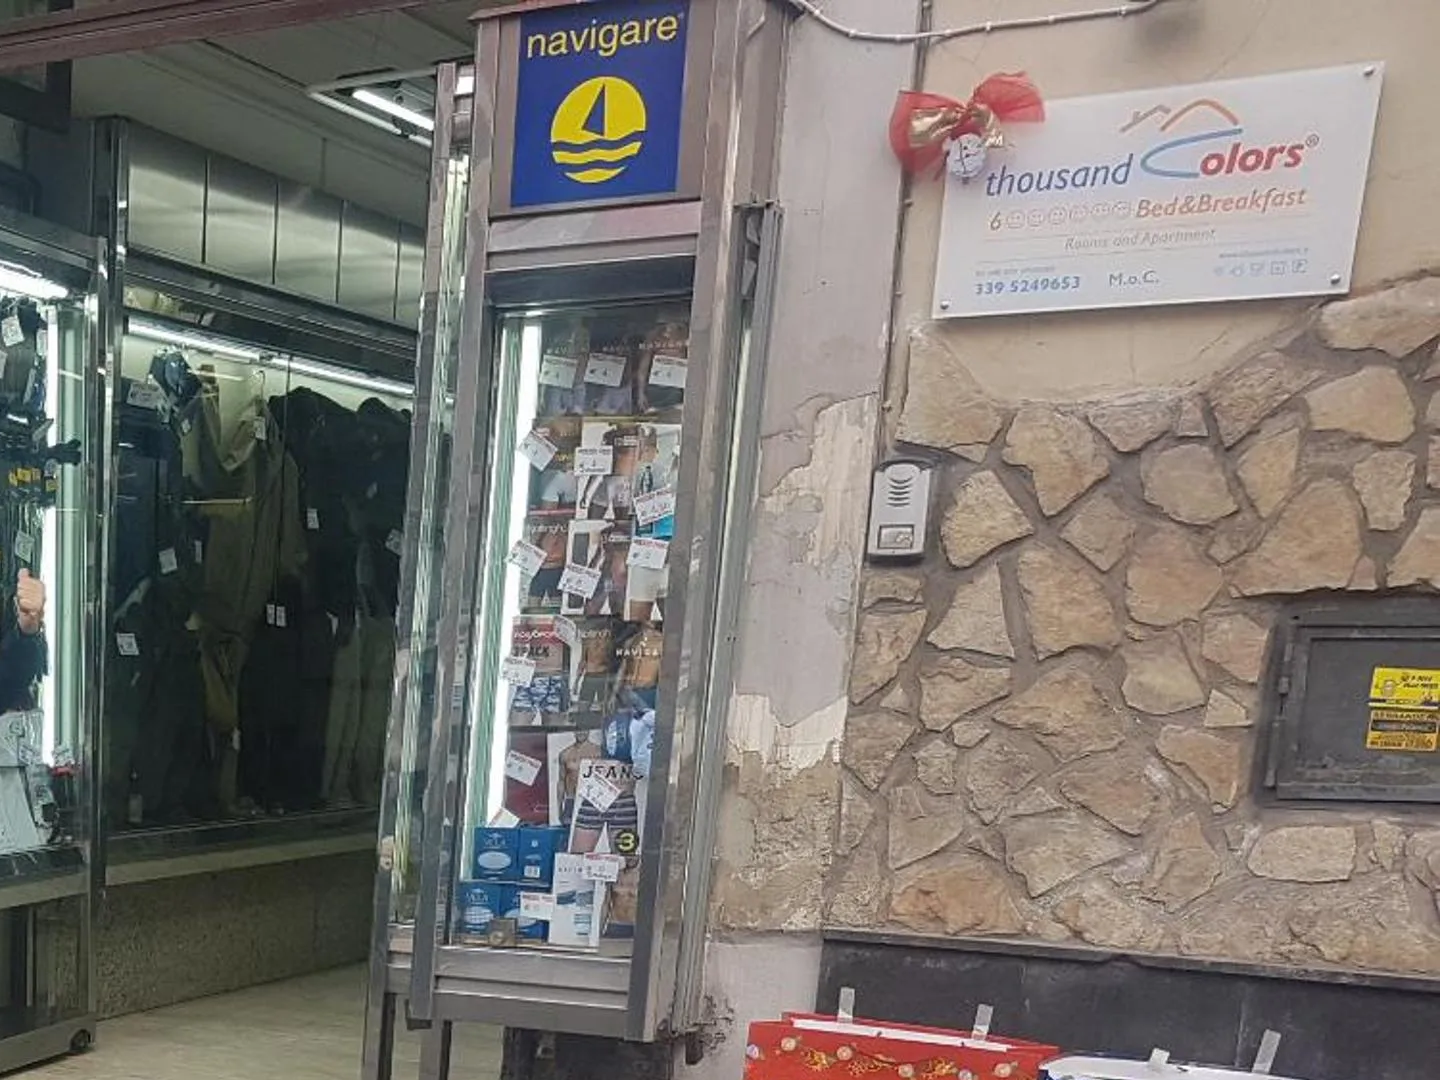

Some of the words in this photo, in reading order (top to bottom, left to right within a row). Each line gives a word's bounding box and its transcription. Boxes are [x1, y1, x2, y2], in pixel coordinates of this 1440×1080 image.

[527, 15, 678, 58] navigare
[986, 153, 1134, 197] thousand
[1065, 236, 1108, 251] Rooms
[1113, 232, 1137, 247] and
[975, 281, 1005, 296] 339
[1010, 275, 1081, 293] 5249653
